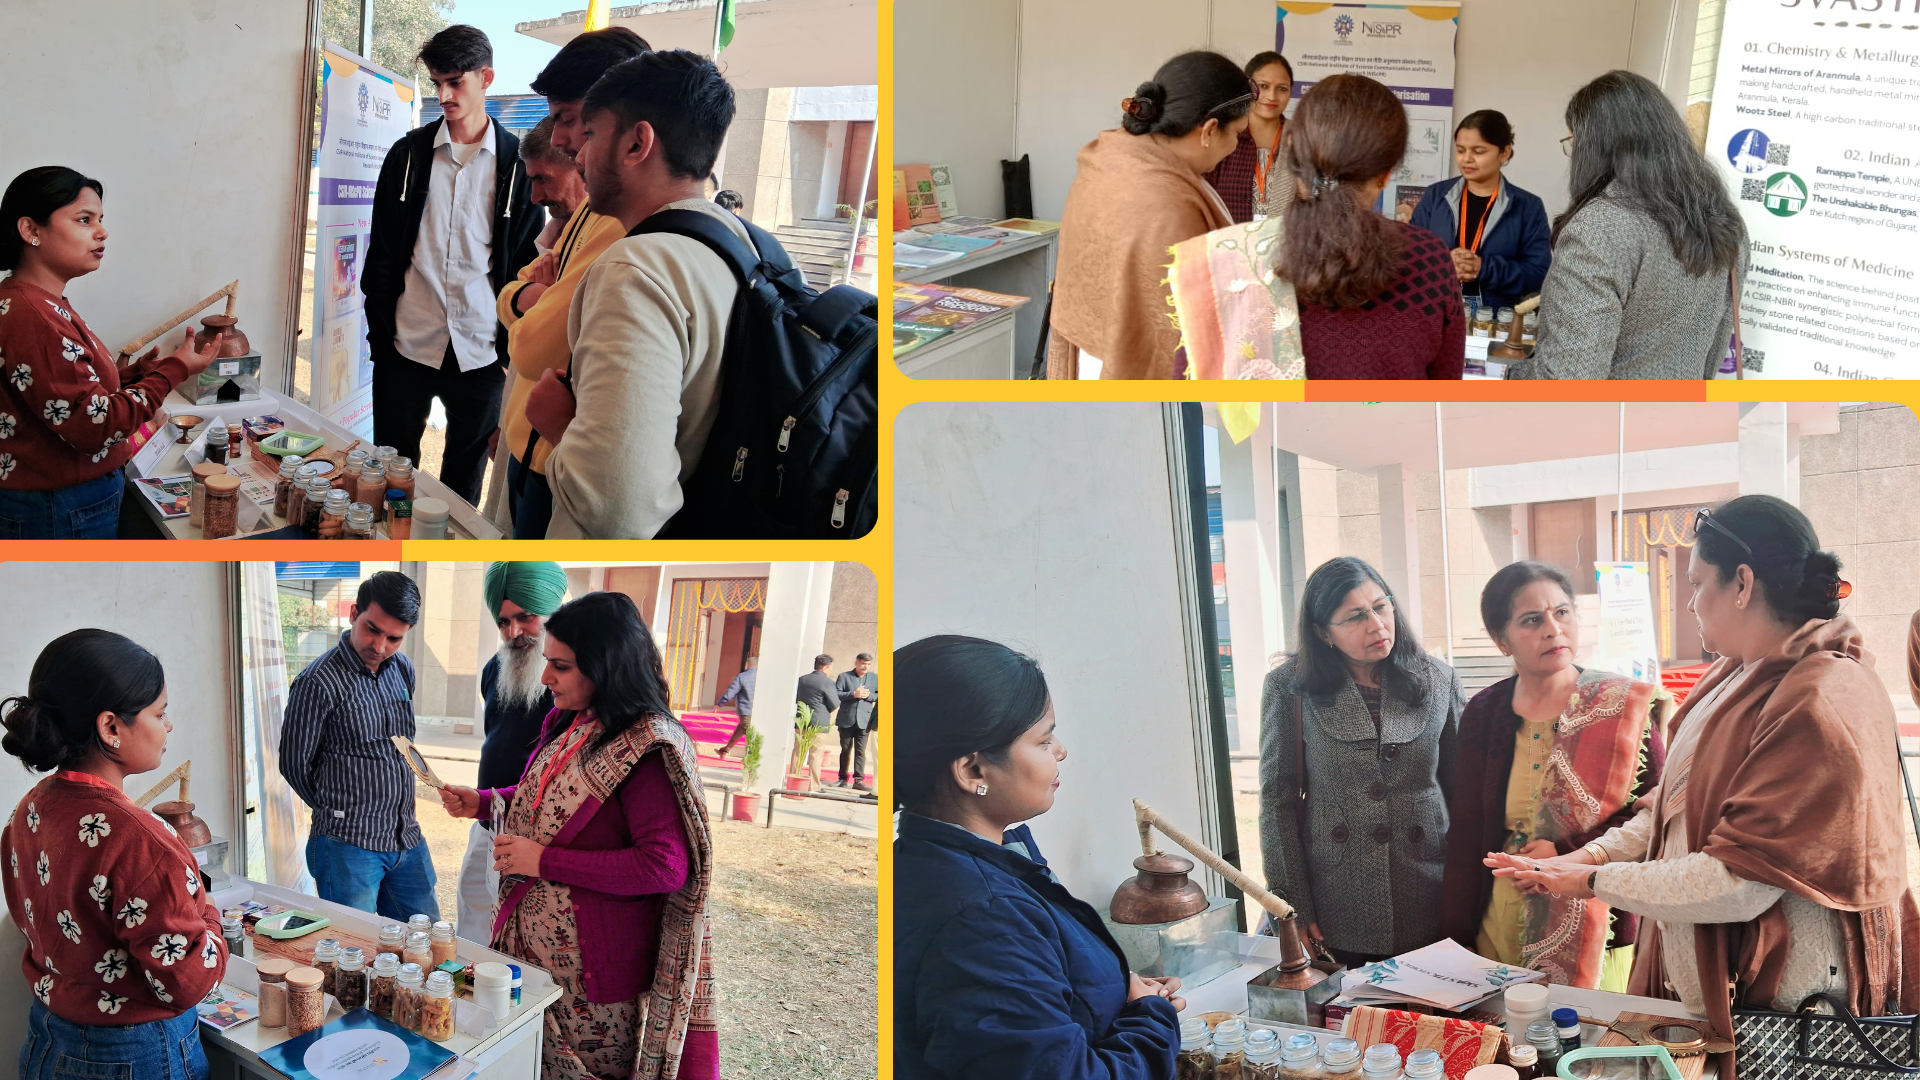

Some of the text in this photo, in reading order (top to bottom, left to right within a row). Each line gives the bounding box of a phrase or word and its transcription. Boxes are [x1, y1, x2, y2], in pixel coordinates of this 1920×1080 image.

[1744, 42, 1920, 68] 01. Chemistry & Metallurg
[1742, 64, 1767, 73] Metal
[1769, 66, 1801, 76] Mirrors
[1804, 69, 1814, 77] of
[1816, 71, 1862, 82] Aranmula,
[1866, 74, 1872, 82] A
[1875, 76, 1906, 86] unique
[1738, 92, 1779, 103] Aranmula,
[1740, 78, 1769, 90] making
[1772, 80, 1827, 94] handcrafted,
[1830, 85, 1872, 96] handheld
[1875, 91, 1901, 99] metal
[1736, 106, 1765, 115] Wootz
[1768, 109, 1792, 119] Steel,
[1795, 111, 1801, 119] A
[1804, 111, 1821, 123] high
[1824, 115, 1856, 124] carbon
[1858, 118, 1905, 130] traditional
[1844, 149, 1863, 161] 02.
[1869, 151, 1910, 167] Indian
[1816, 166, 1856, 179] Ramappa
[1857, 171, 1892, 184] Temple,
[1812, 194, 1828, 203] The
[1830, 196, 1878, 210] Unshakable
[1814, 182, 1865, 194] geotechnical
[1866, 189, 1898, 199] wonder
[1899, 193, 1916, 202] and
[1824, 211, 1847, 221] Kutch
[1848, 216, 1874, 225] region
[1749, 240, 1914, 279] dian Systems of Medicine
[1756, 265, 1805, 282] Meditation,
[1808, 274, 1824, 285] The
[1826, 280, 1860, 292] science
[1862, 285, 1894, 299] behind
[1758, 281, 1792, 293] practice
[1794, 288, 1805, 296] on
[1807, 290, 1850, 307] enhancing
[1853, 299, 1890, 312] immune
[1752, 292, 1796, 307] CSIR-NBRI
[1798, 301, 1844, 318] synergistic
[1846, 312, 1894, 328] polyherbal
[1741, 303, 1767, 317] kidney
[1769, 310, 1793, 320] stone
[1796, 316, 1825, 327] related
[1828, 322, 1875, 339] conditions
[1878, 332, 1907, 346] based
[1760, 322, 1798, 335] validated
[1800, 330, 1843, 346] traditional
[1845, 340, 1896, 359] knowledge
[1814, 361, 1832, 375] 04.
